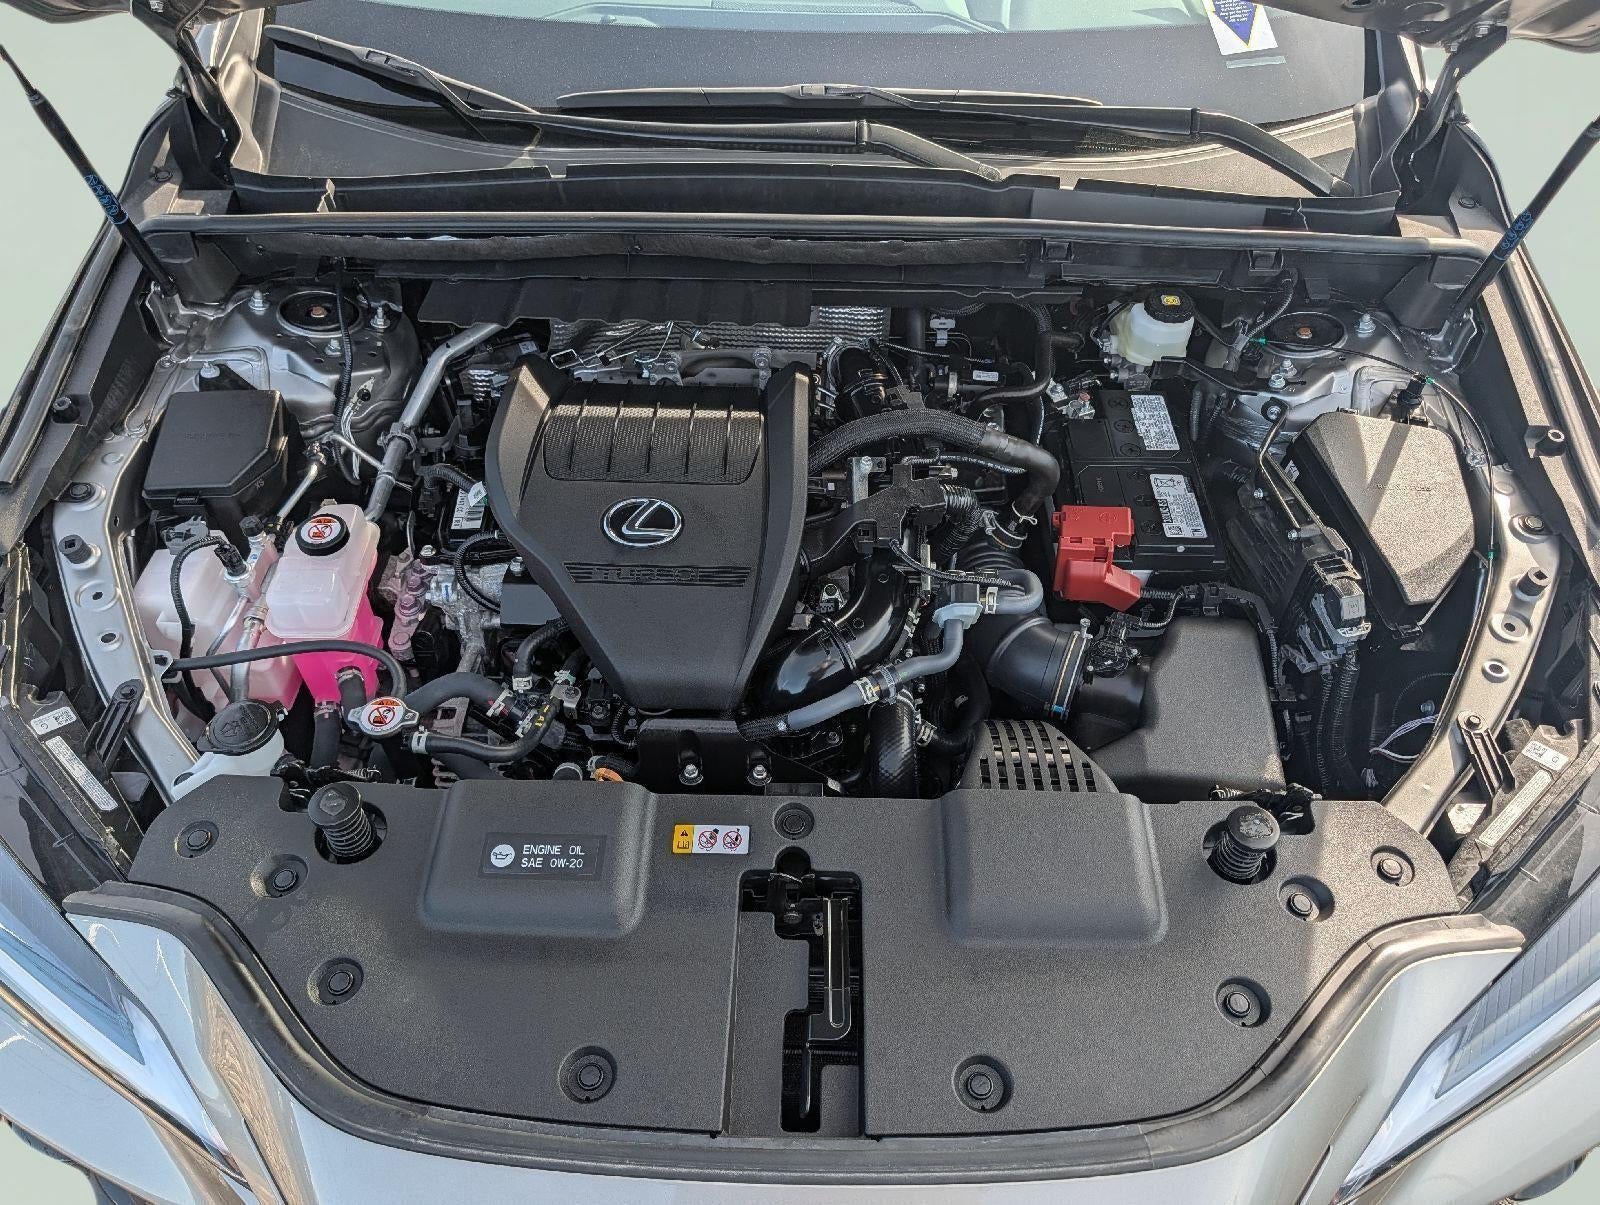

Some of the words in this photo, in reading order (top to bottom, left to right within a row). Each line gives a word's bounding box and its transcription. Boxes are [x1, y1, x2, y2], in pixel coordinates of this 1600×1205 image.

[594, 566, 699, 583] TURBO
[522, 844, 562, 856] ENGINE
[568, 845, 585, 856] OIL
[521, 857, 543, 869] SAE
[549, 858, 584, 869] 0W-20
